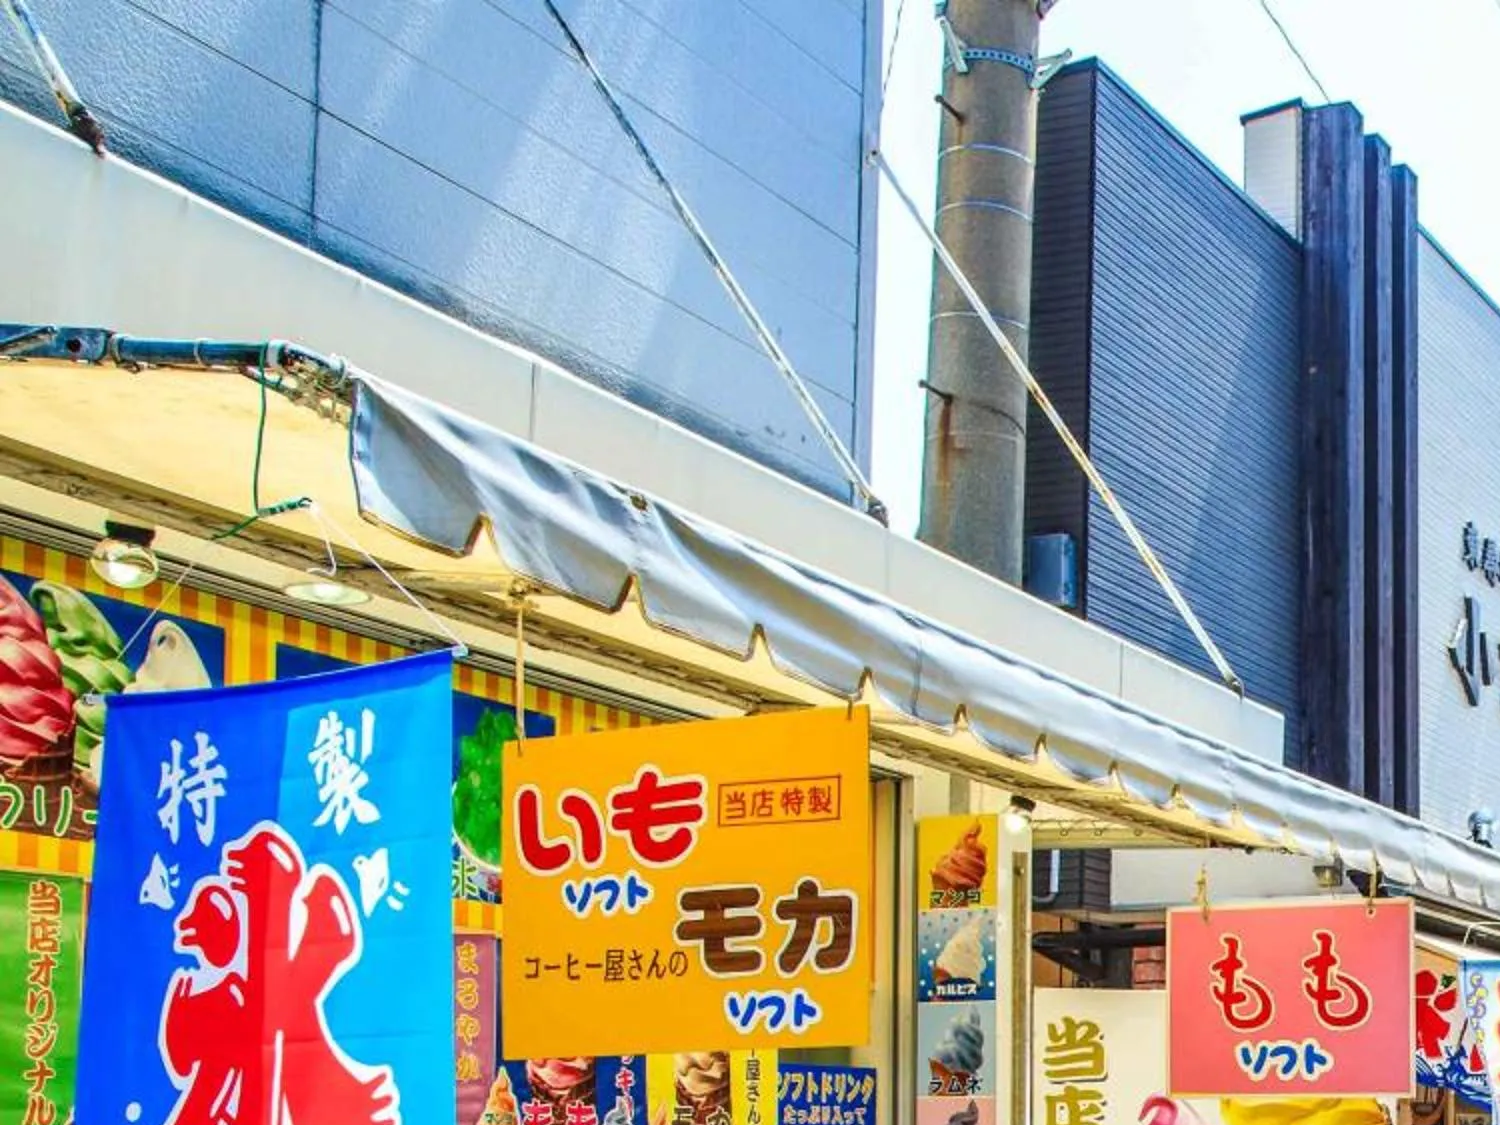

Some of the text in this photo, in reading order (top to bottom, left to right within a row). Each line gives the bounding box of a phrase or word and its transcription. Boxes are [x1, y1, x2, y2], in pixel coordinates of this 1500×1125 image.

[517, 768, 705, 873] いも
[723, 785, 834, 820] 当店特製
[565, 878, 651, 914] ソフト
[677, 880, 854, 975] モカ
[524, 950, 689, 984] コーヒー屋さんの
[1209, 930, 1373, 1030] もも
[727, 995, 819, 1032] ソフト
[1240, 1042, 1328, 1077] ソフト
